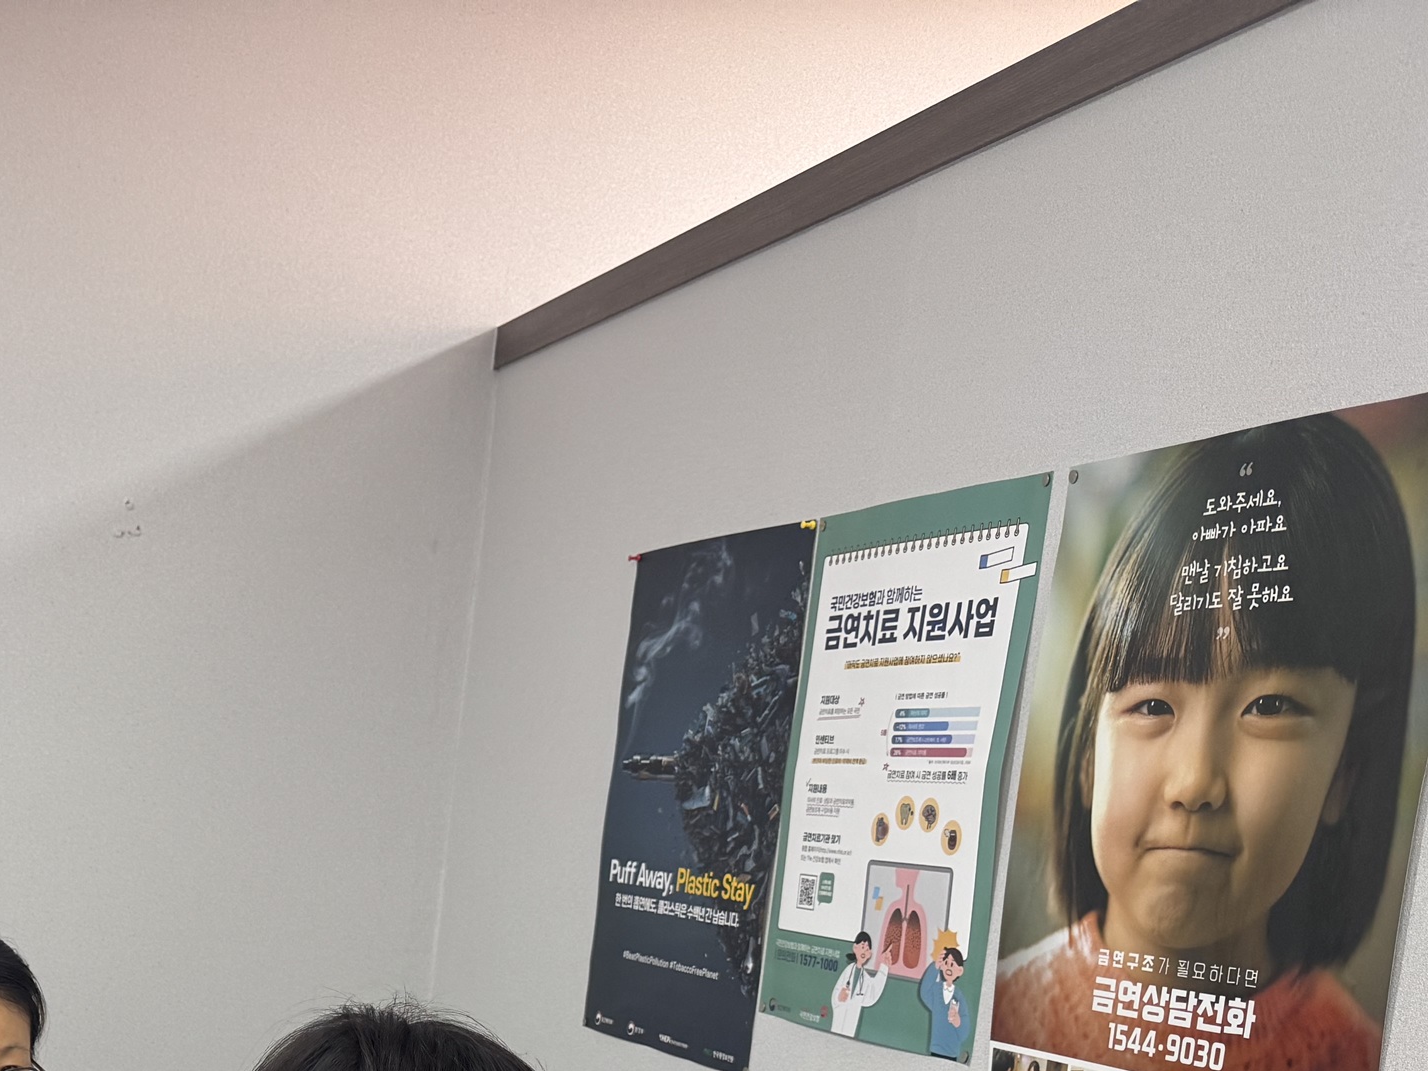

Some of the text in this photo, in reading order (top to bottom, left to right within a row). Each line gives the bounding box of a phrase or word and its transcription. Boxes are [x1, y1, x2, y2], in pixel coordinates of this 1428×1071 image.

[1203, 489, 1281, 516] 도와주세요,
[1192, 514, 1287, 541] 아빠가 아파요
[1182, 554, 1288, 585] 맨날 기침하고요
[830, 585, 923, 611] 국민건강보험과 함께하는
[1170, 582, 1293, 616] 달리기도 잘 못해요
[825, 596, 999, 650] 금연치료 지원사업
[609, 859, 755, 910] Puff Away, Plastic Stay
[614, 892, 621, 907] 한
[621, 894, 633, 909] 번의
[657, 899, 687, 919] 플라스틱은
[799, 953, 838, 972] 1577-1000
[1097, 948, 1259, 988] 금연구조가 필요하다면
[1092, 976, 1256, 1039] 금연상담전화
